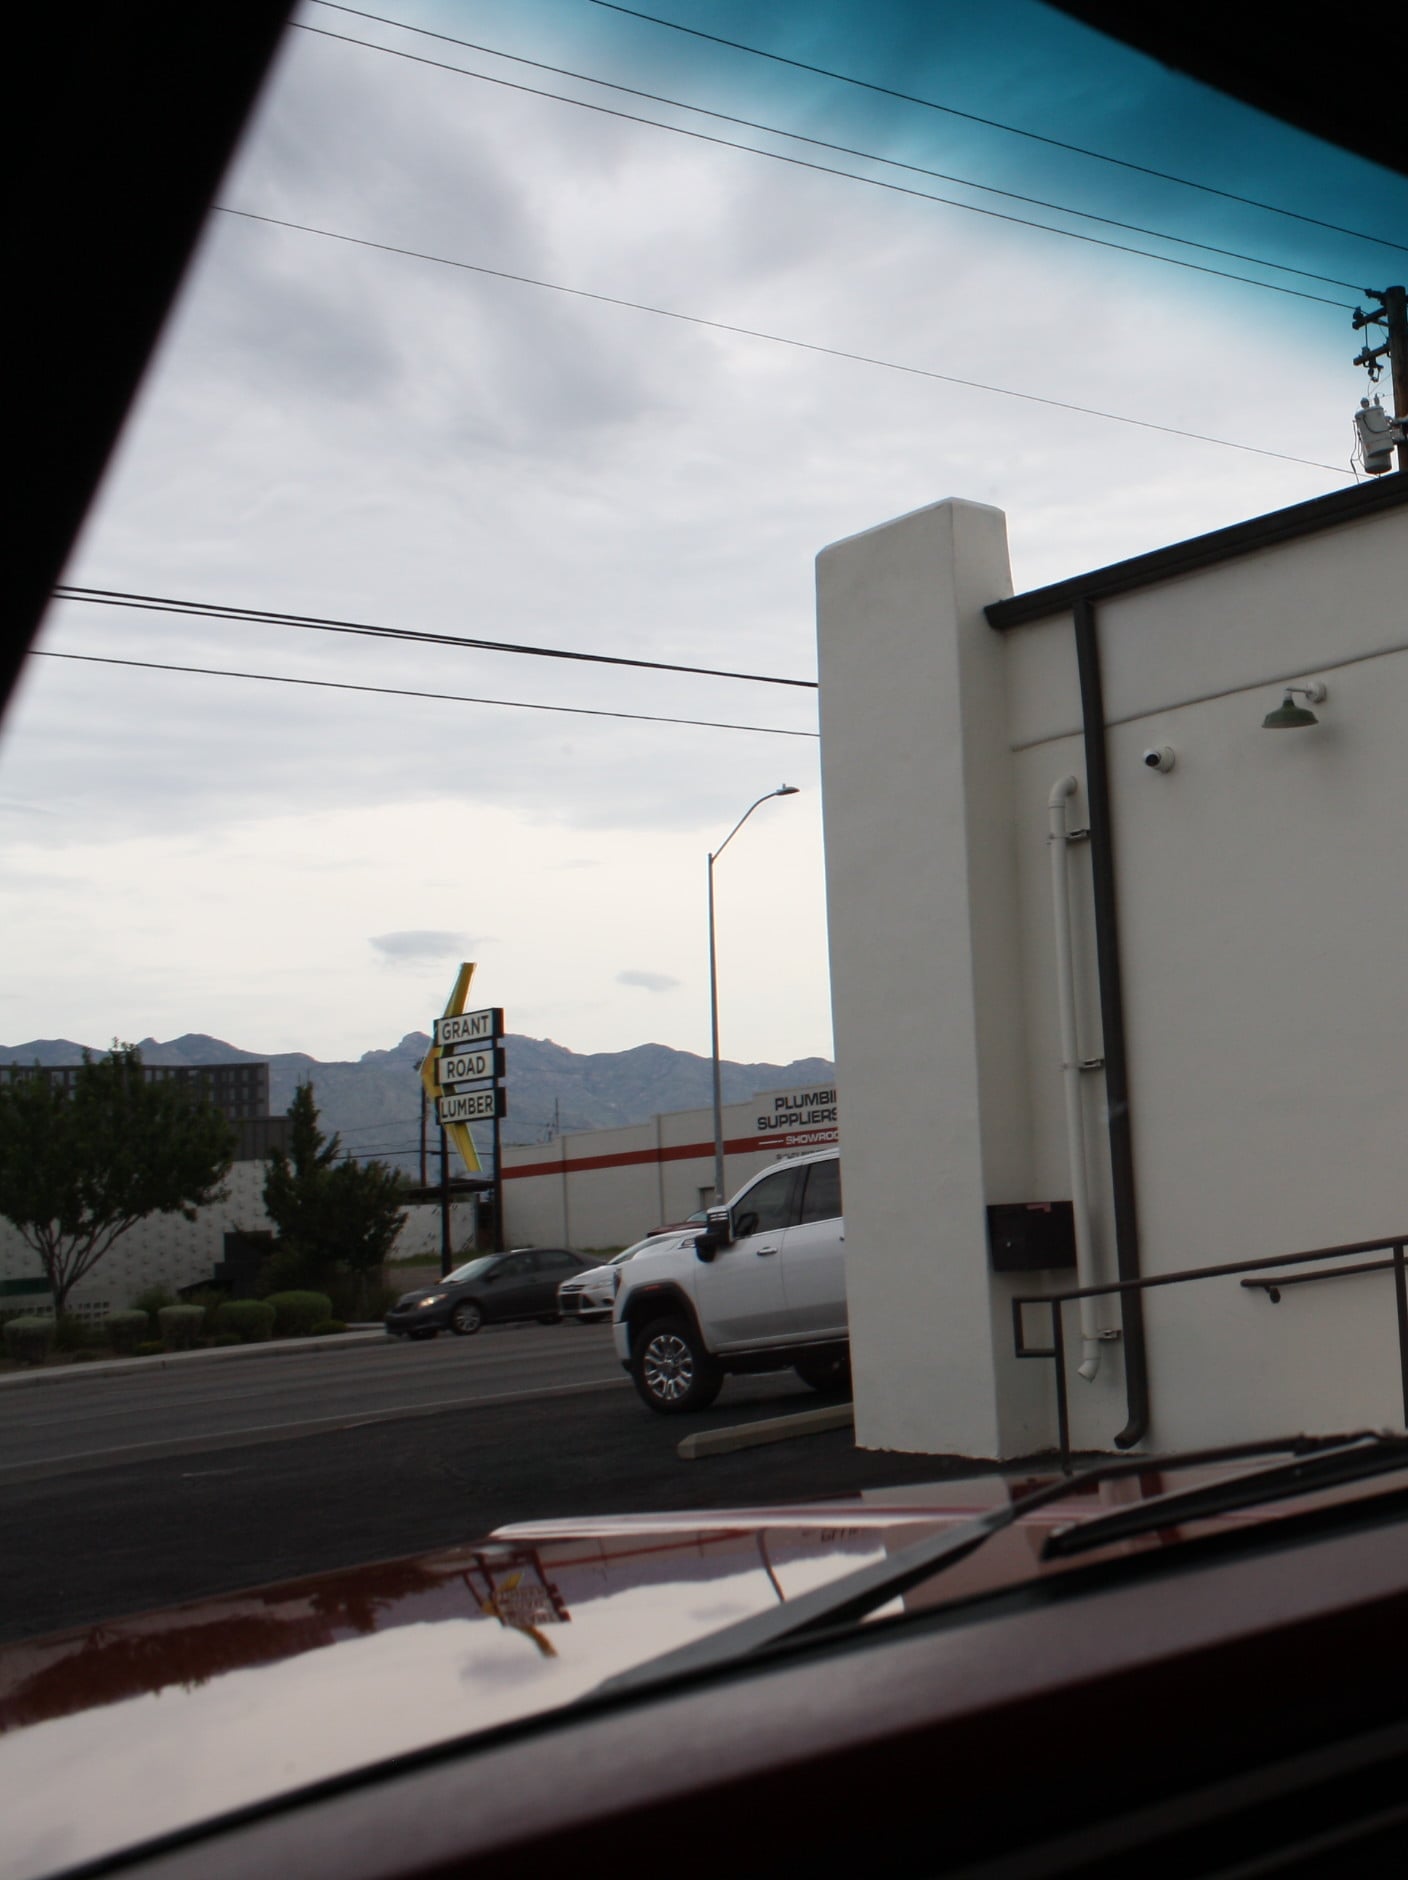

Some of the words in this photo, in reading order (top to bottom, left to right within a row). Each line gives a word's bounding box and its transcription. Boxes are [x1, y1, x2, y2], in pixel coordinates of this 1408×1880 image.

[442, 1015, 489, 1040] GRANT
[447, 1056, 486, 1078] ROAD
[441, 1095, 493, 1118] LUMBER
[775, 1090, 836, 1111] PLUMBI
